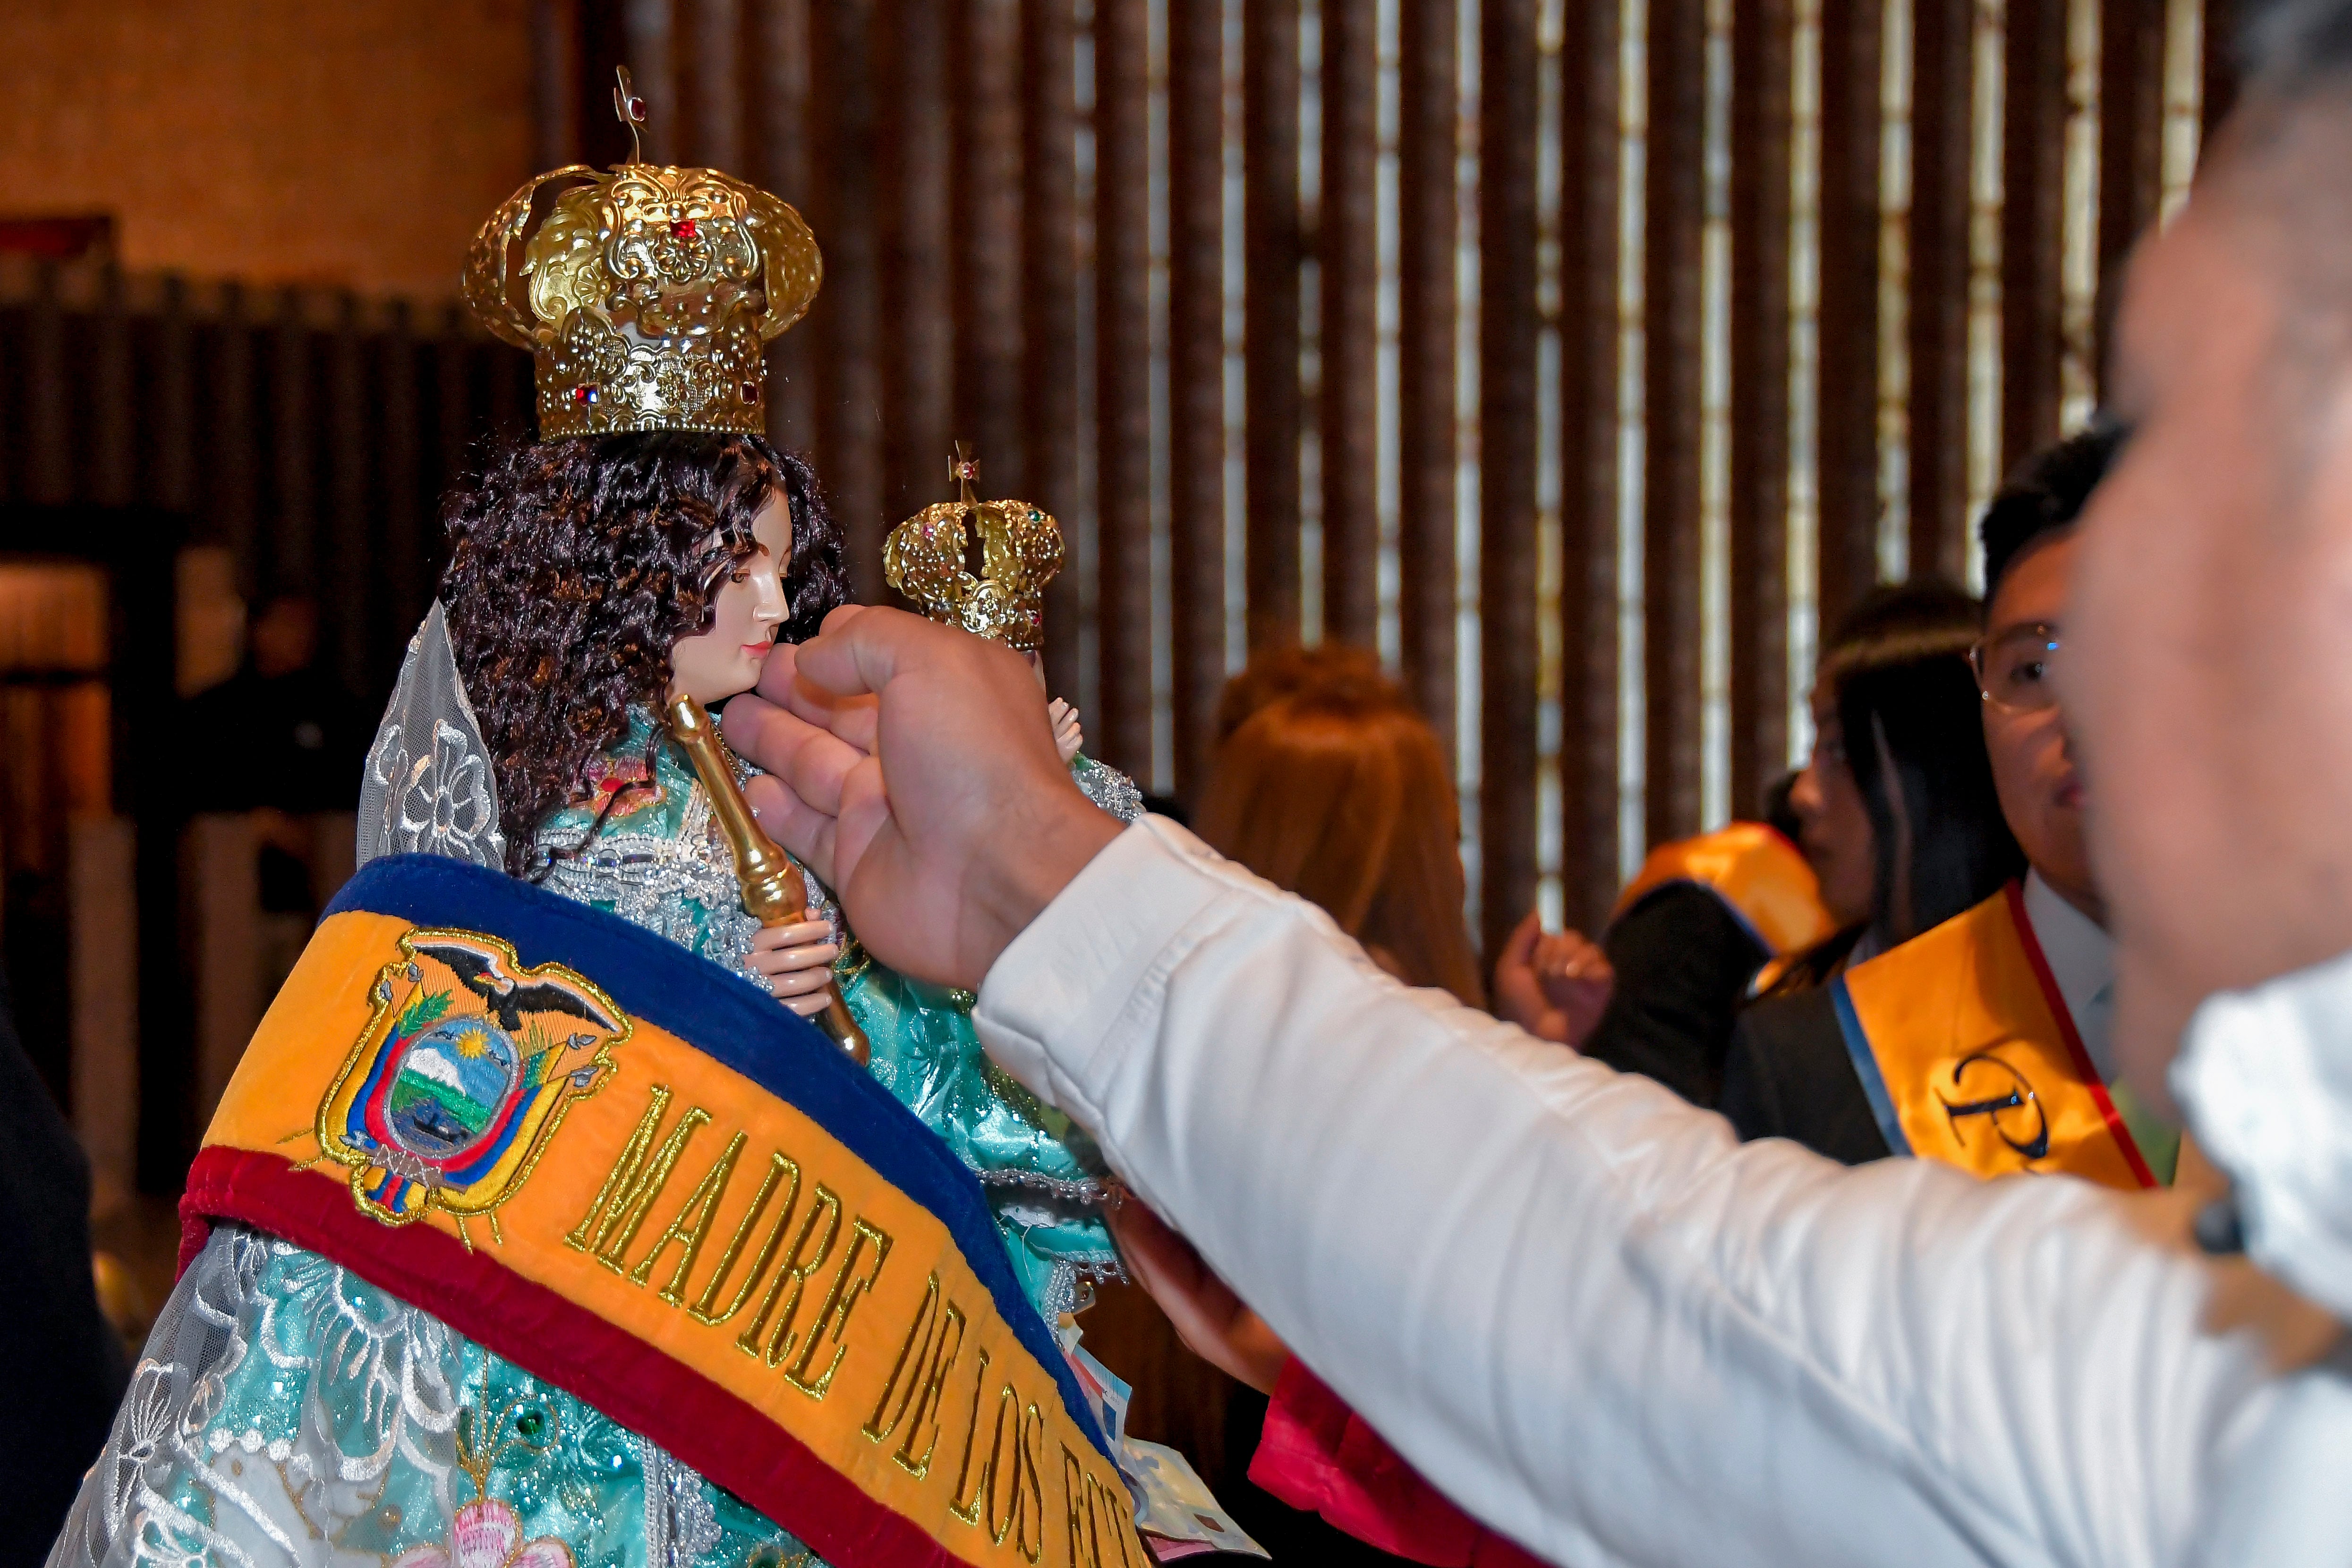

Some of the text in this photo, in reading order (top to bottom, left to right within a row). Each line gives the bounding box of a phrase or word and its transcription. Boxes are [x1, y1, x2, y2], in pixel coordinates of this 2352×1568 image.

[563, 1084, 894, 1401] MADRE
[861, 1270, 967, 1481] DE
[949, 1345, 1042, 1566] LOS
